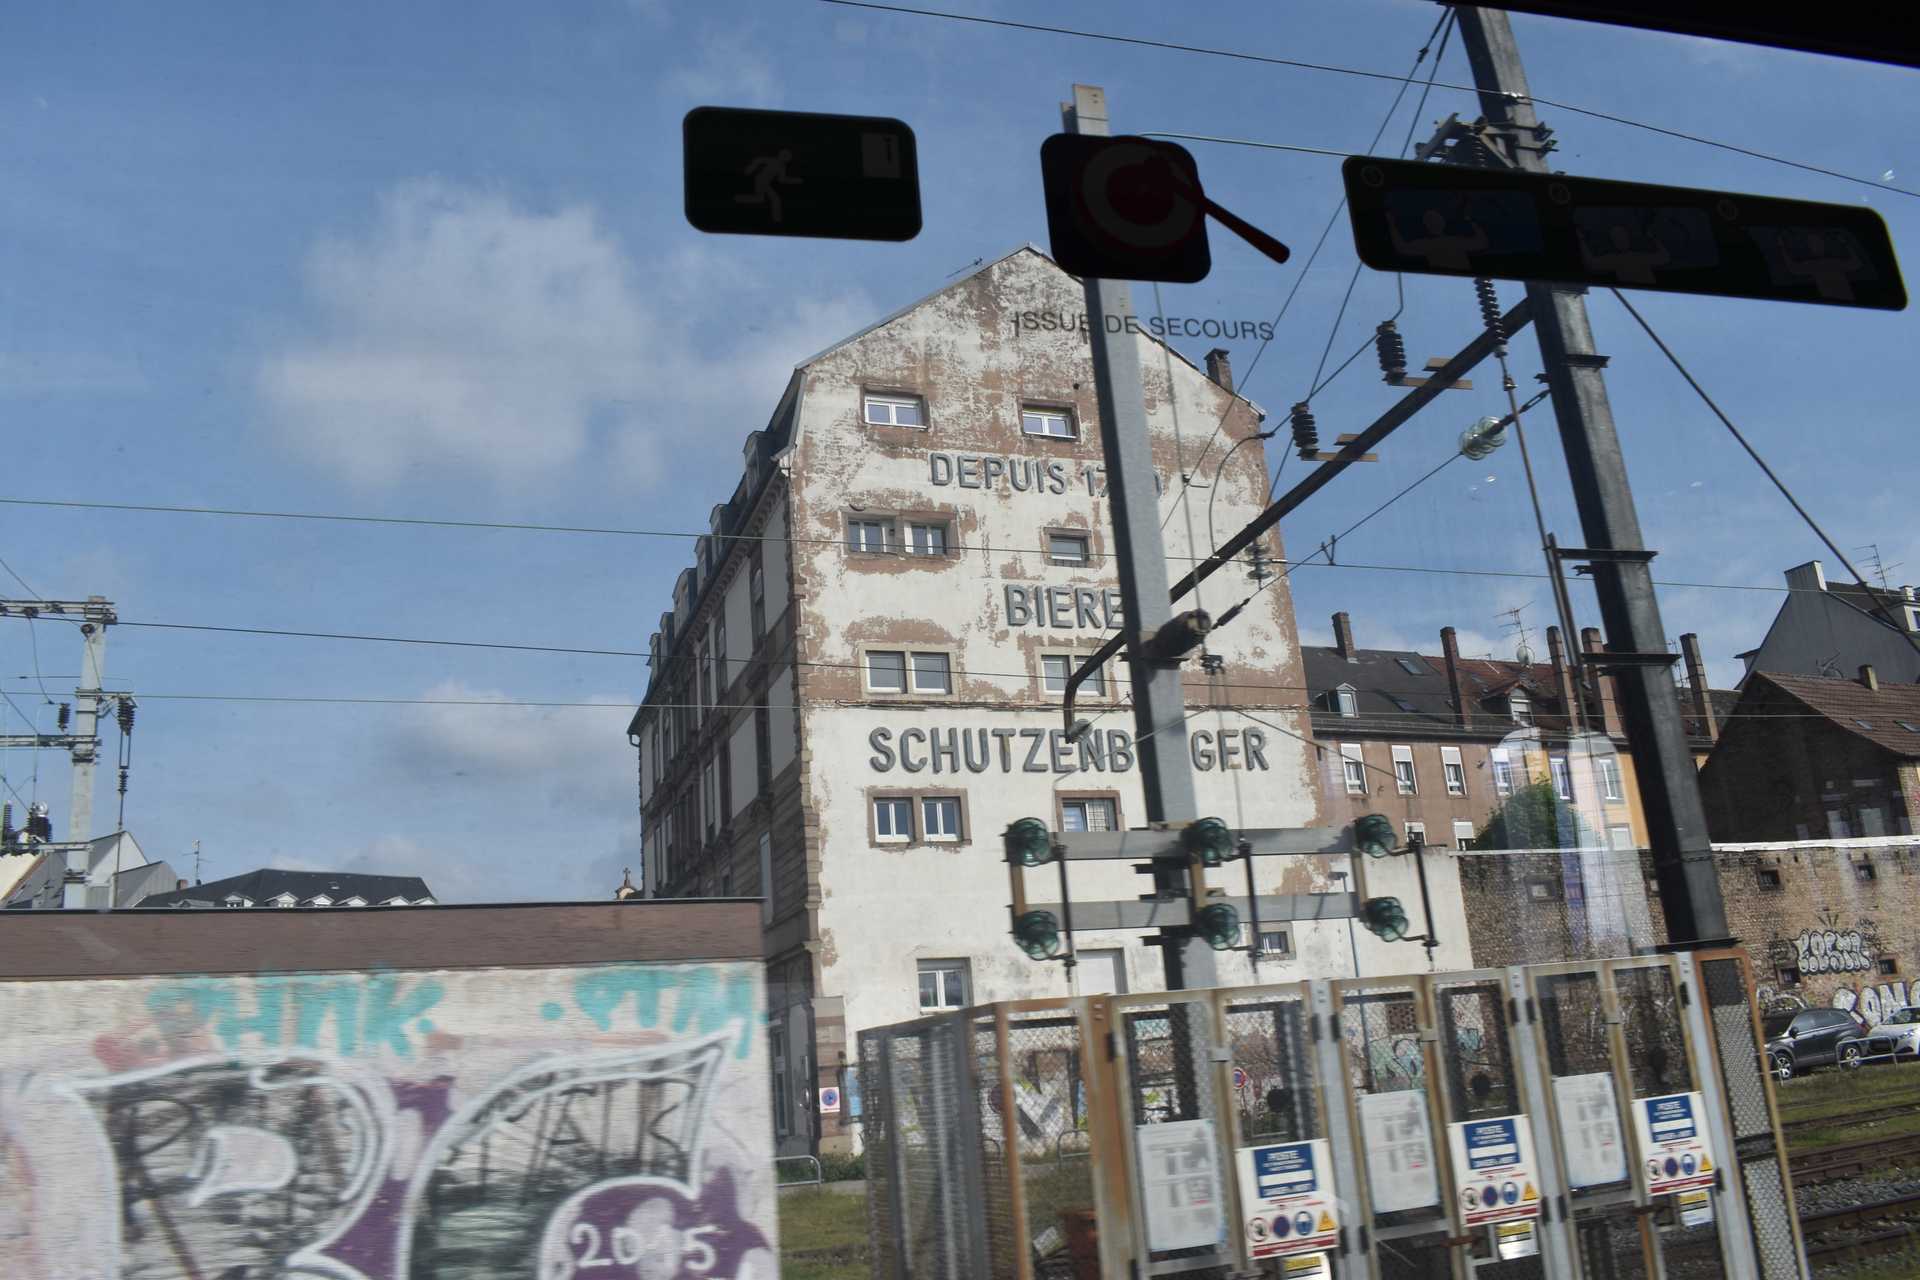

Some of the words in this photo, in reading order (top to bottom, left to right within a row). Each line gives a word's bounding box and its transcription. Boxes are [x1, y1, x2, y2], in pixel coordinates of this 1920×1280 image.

[1104, 314, 1139, 335] DE
[1150, 316, 1274, 342] SECOURS
[928, 452, 1068, 494] DEPUIS
[868, 725, 1271, 774] SCHUTZENBGER
